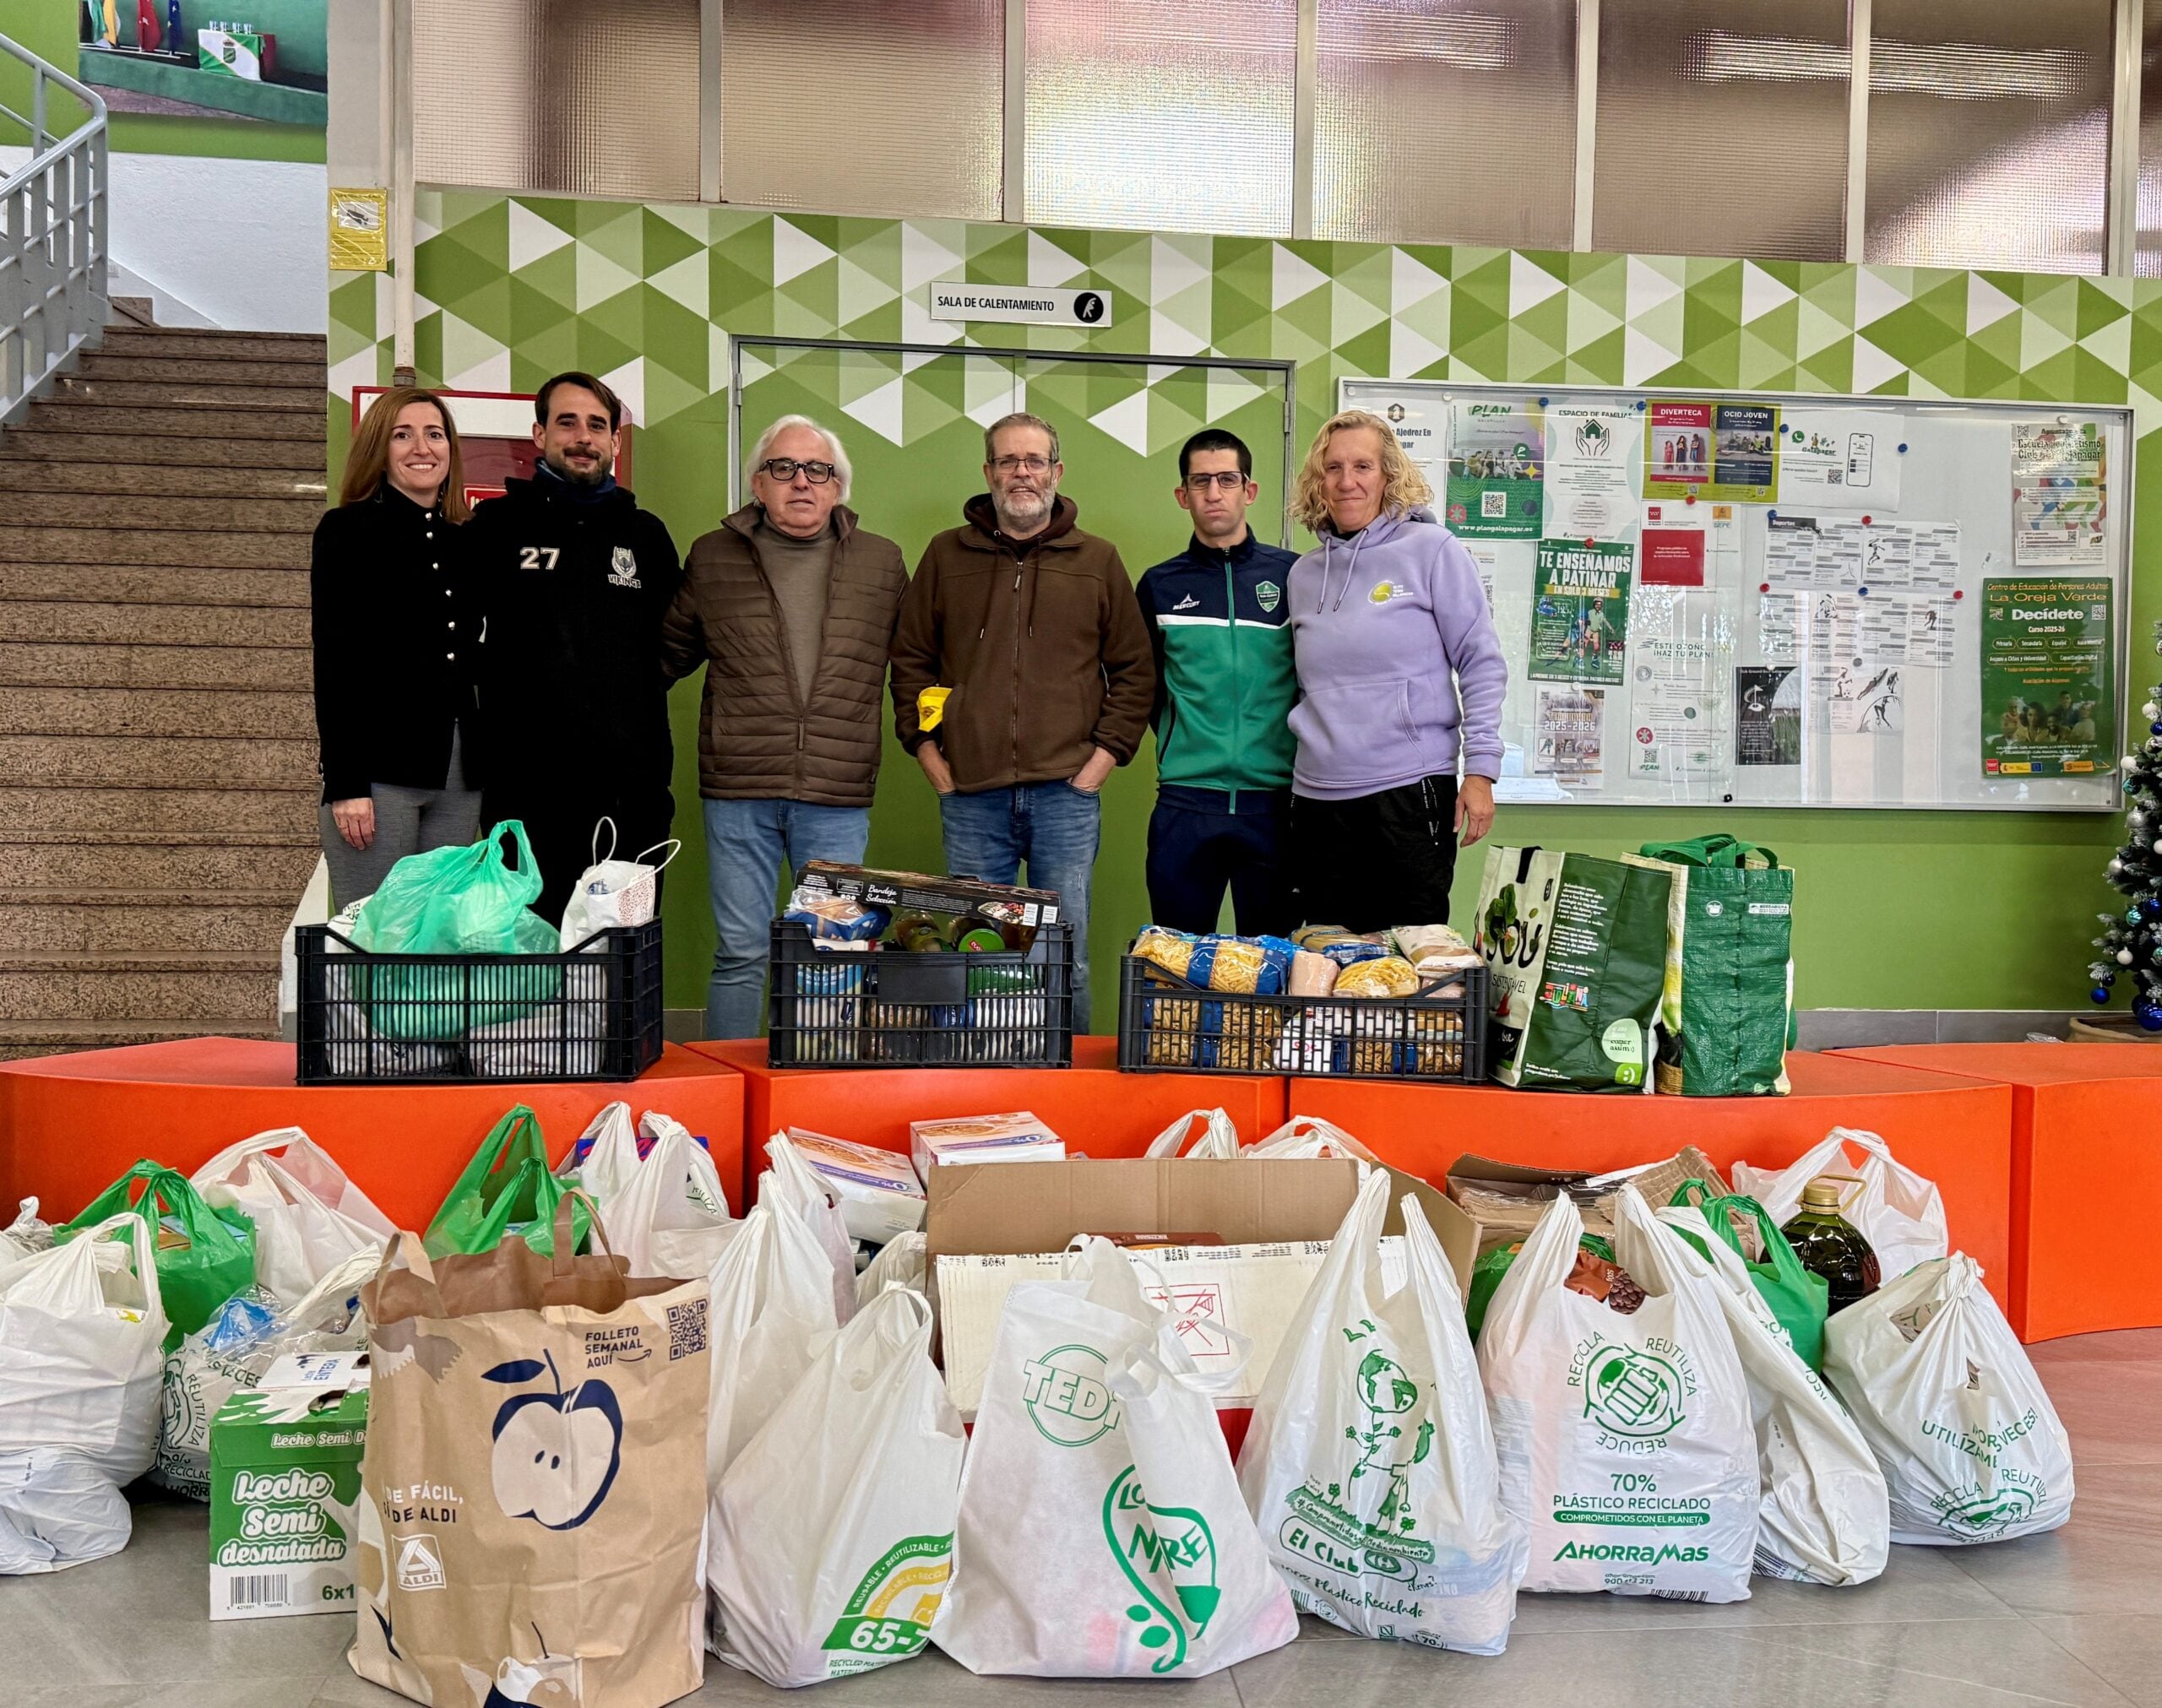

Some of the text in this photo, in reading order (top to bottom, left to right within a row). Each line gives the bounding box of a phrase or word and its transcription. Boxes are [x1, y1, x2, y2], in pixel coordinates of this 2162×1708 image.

[938, 296, 1055, 312] SALA DE CALENTAMIENTO
[1472, 405, 1512, 416] PLAN
[1459, 525, 1533, 534] www.plangalapagar.es
[520, 547, 560, 570] 27
[1540, 551, 1631, 572] TE ENSEÑAMOS
[607, 573, 641, 588] VIKINGS
[1549, 568, 1616, 588] A PATINAR
[1554, 586, 1562, 594] EN
[1563, 586, 1580, 595] SOLO
[2014, 593, 2056, 604] Oreja
[2062, 593, 2107, 601] Verde
[2012, 608, 2083, 621] Decídete
[1544, 720, 1595, 731] 2025-2026
[866, 894, 896, 905] Selección
[868, 885, 897, 897] Bandeja
[585, 1326, 639, 1342] FOLLETO
[585, 1338, 644, 1354] SEMANAL
[587, 1352, 612, 1369] AQUÍ
[1646, 1337, 1698, 1397] REUTILIZA
[314, 1358, 341, 1382] ENTERA
[187, 1373, 206, 1446] REUTILIZA
[1998, 1407, 2038, 1445] VECES!
[272, 1434, 314, 1448] Leche
[317, 1432, 352, 1446] Semi
[233, 1468, 334, 1504] Leche
[410, 1479, 464, 1505] FÁCIL,
[1611, 1473, 1656, 1494] 70%
[1553, 1492, 1711, 1510] PLÁSTICO RECICLADO
[241, 1502, 326, 1538] Semi
[421, 1506, 456, 1523] ALDI
[1560, 1512, 1704, 1525] COMPROMETIDOS CON EL PLANETA
[218, 1536, 347, 1567] desnatada
[1289, 1528, 1360, 1573] El Club
[403, 1573, 439, 1586] ALDI
[853, 1571, 883, 1608] REUSABLE
[885, 1543, 939, 1568] REUTILIZABLE
[322, 1584, 355, 1601] 6x1
